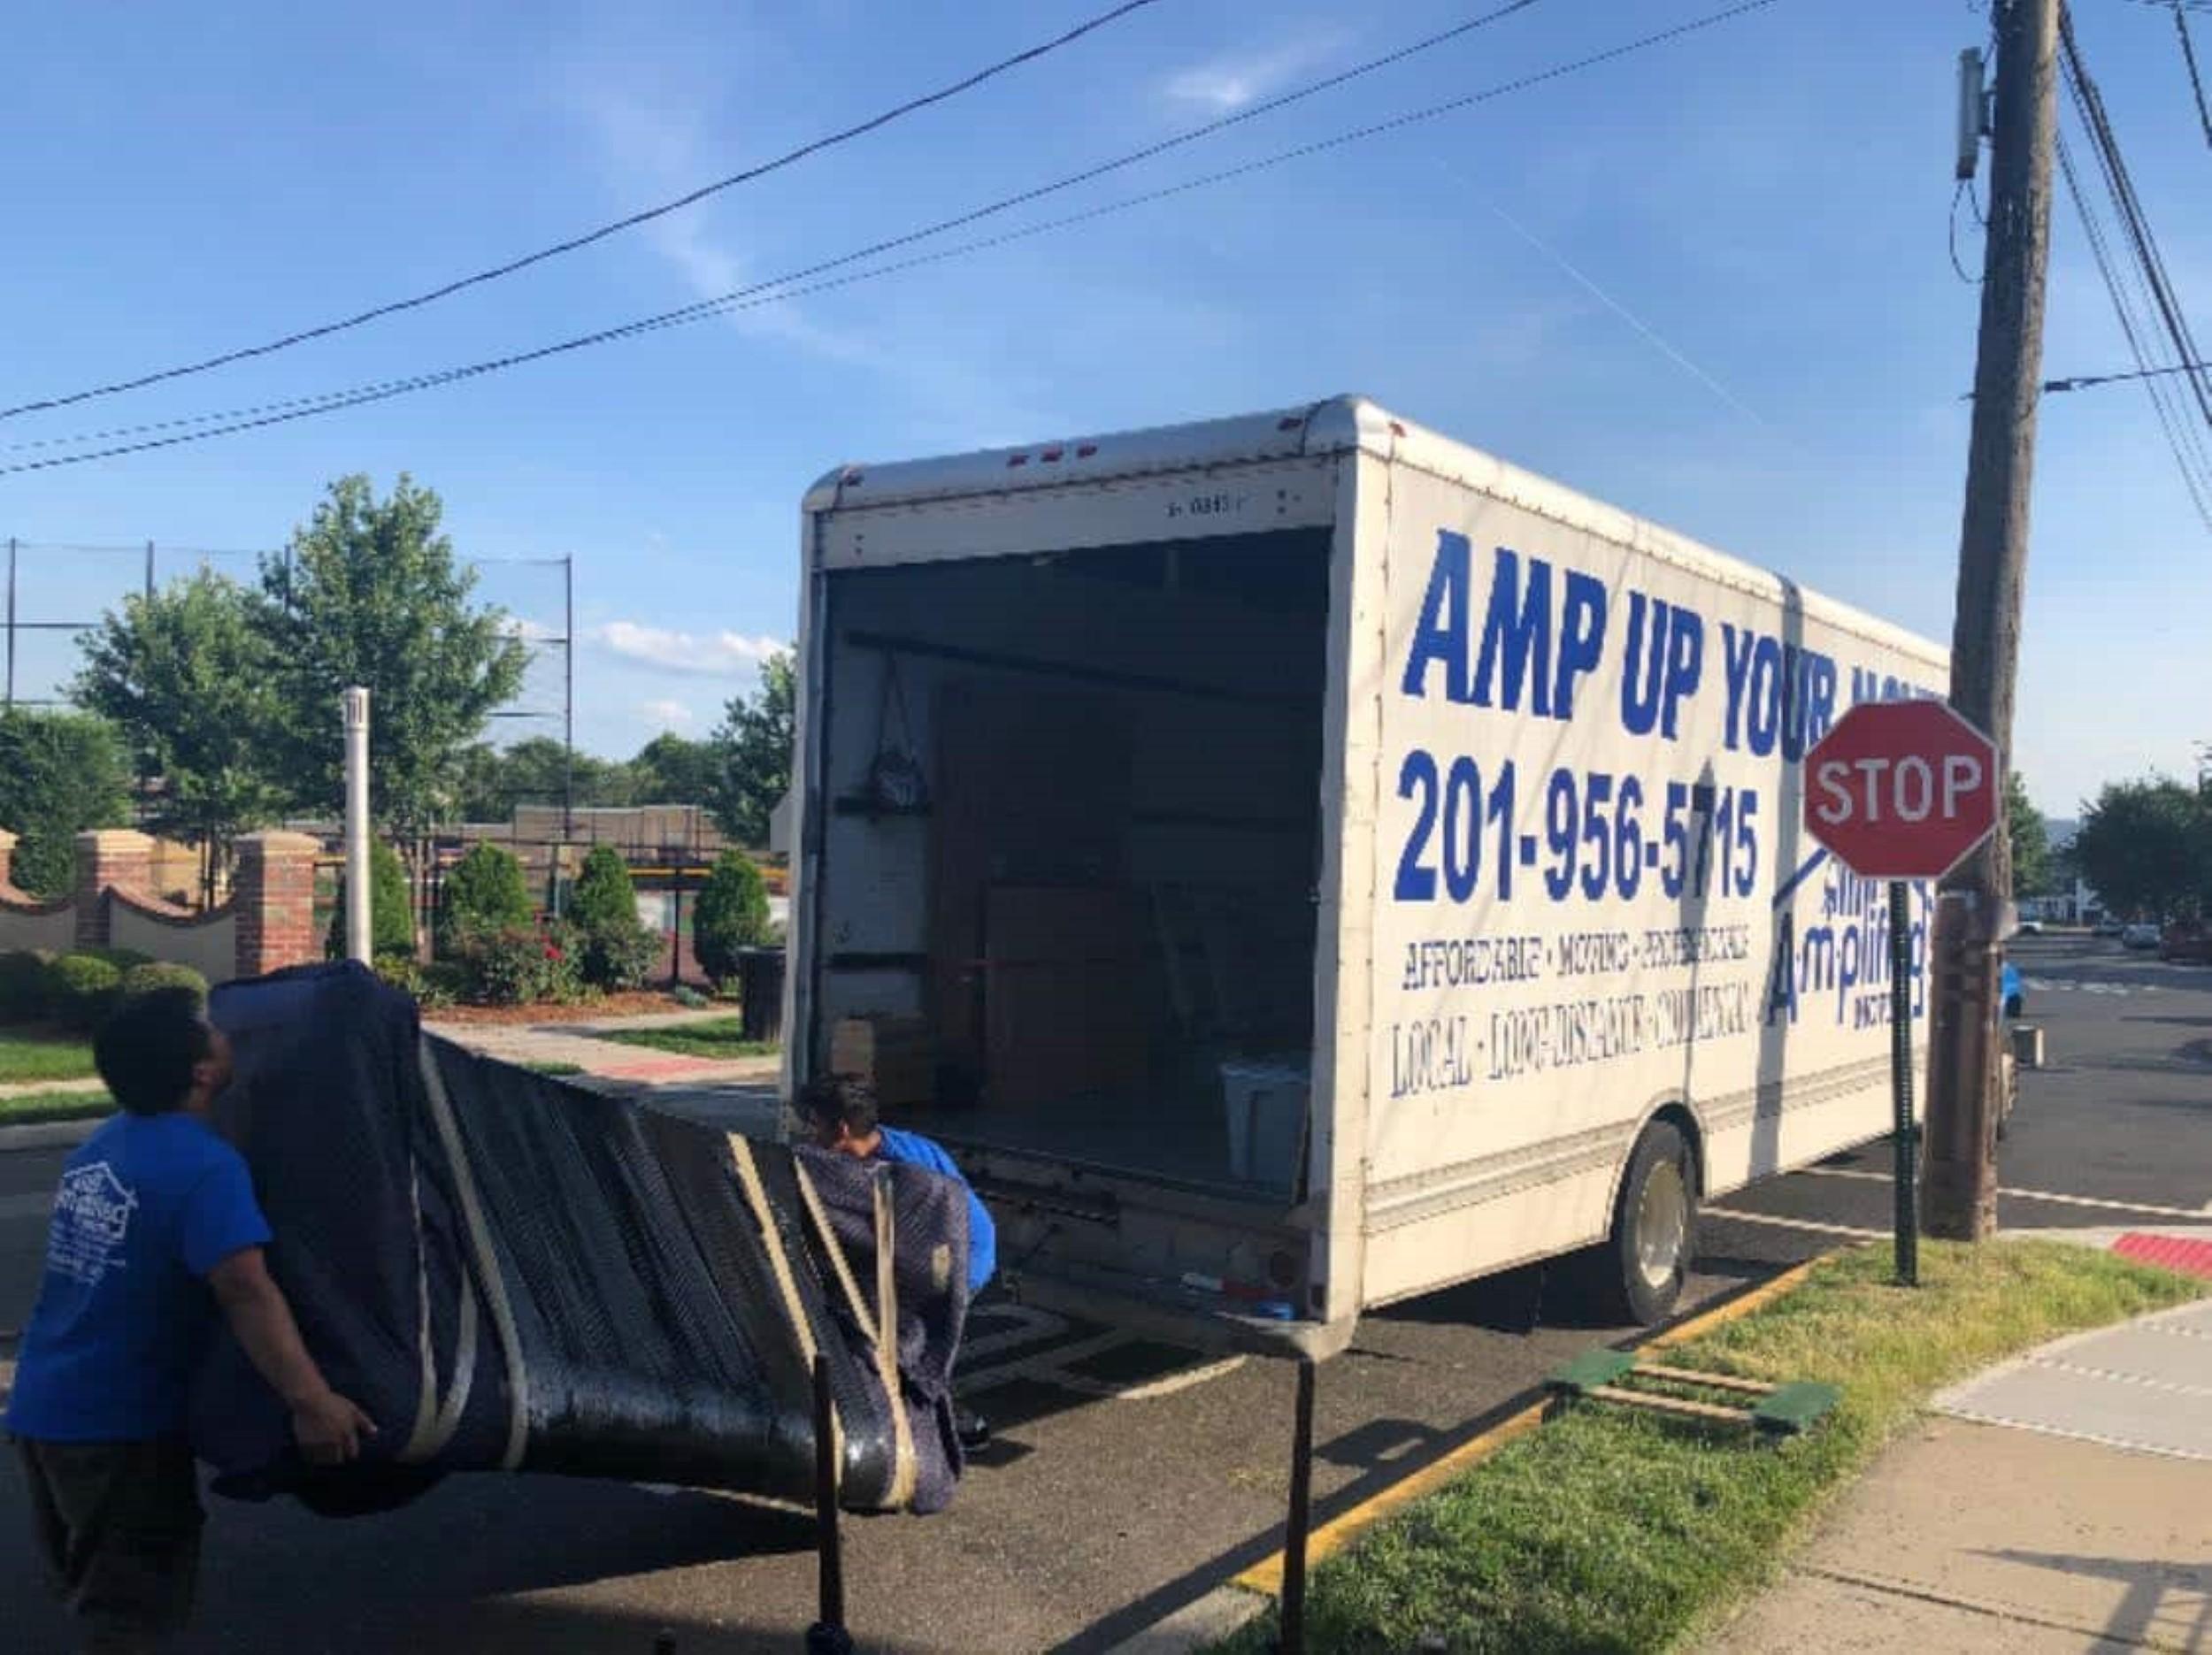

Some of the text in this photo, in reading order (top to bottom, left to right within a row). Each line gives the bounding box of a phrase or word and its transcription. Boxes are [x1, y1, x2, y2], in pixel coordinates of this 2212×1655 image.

[1402, 529, 1838, 765] AMP UP YOUR
[1394, 749, 1758, 904] 201-956-5715
[1816, 755, 1982, 824] STOP
[1402, 936, 1542, 991] AFFORDABLE
[1390, 1015, 1472, 1099] LOCAL
